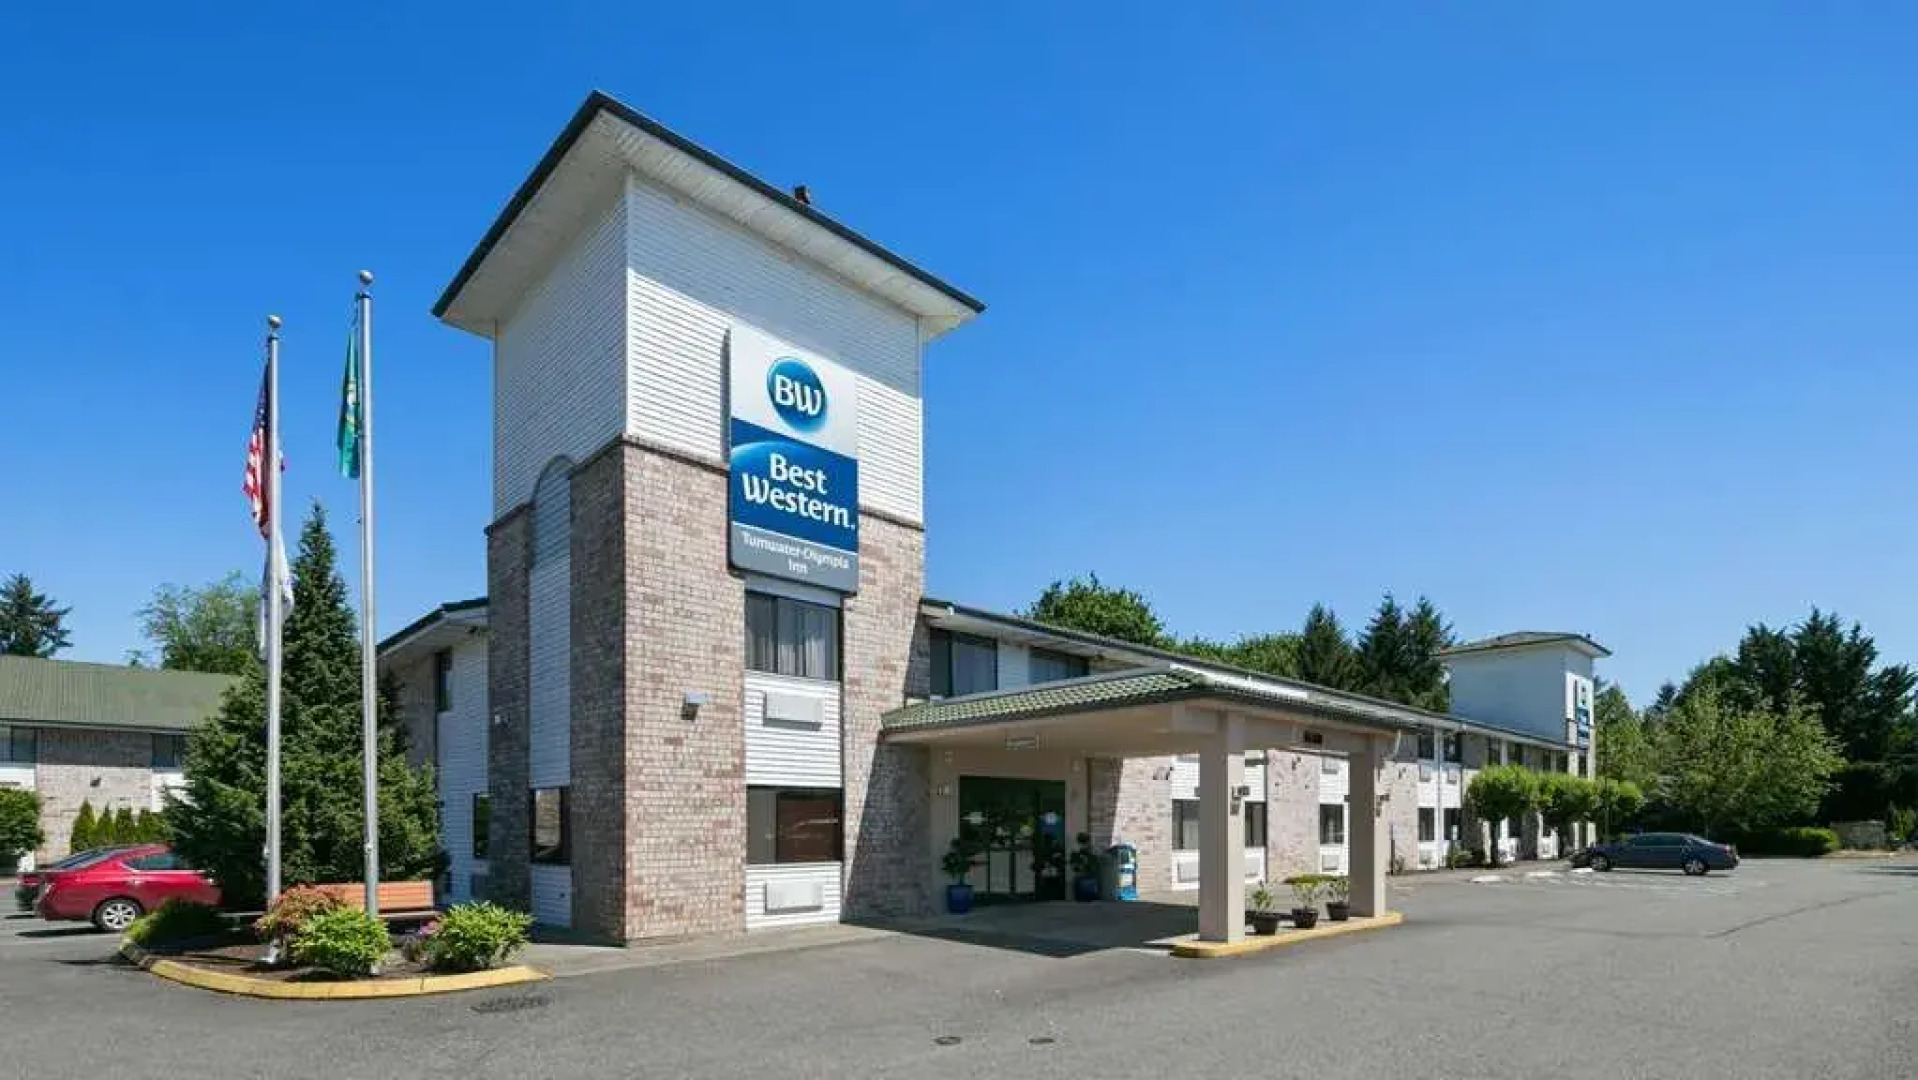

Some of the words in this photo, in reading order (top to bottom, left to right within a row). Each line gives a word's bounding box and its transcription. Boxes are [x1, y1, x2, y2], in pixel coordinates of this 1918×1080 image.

[774, 373, 821, 416] BW
[769, 453, 828, 495] Best
[788, 560, 808, 574] Inn
